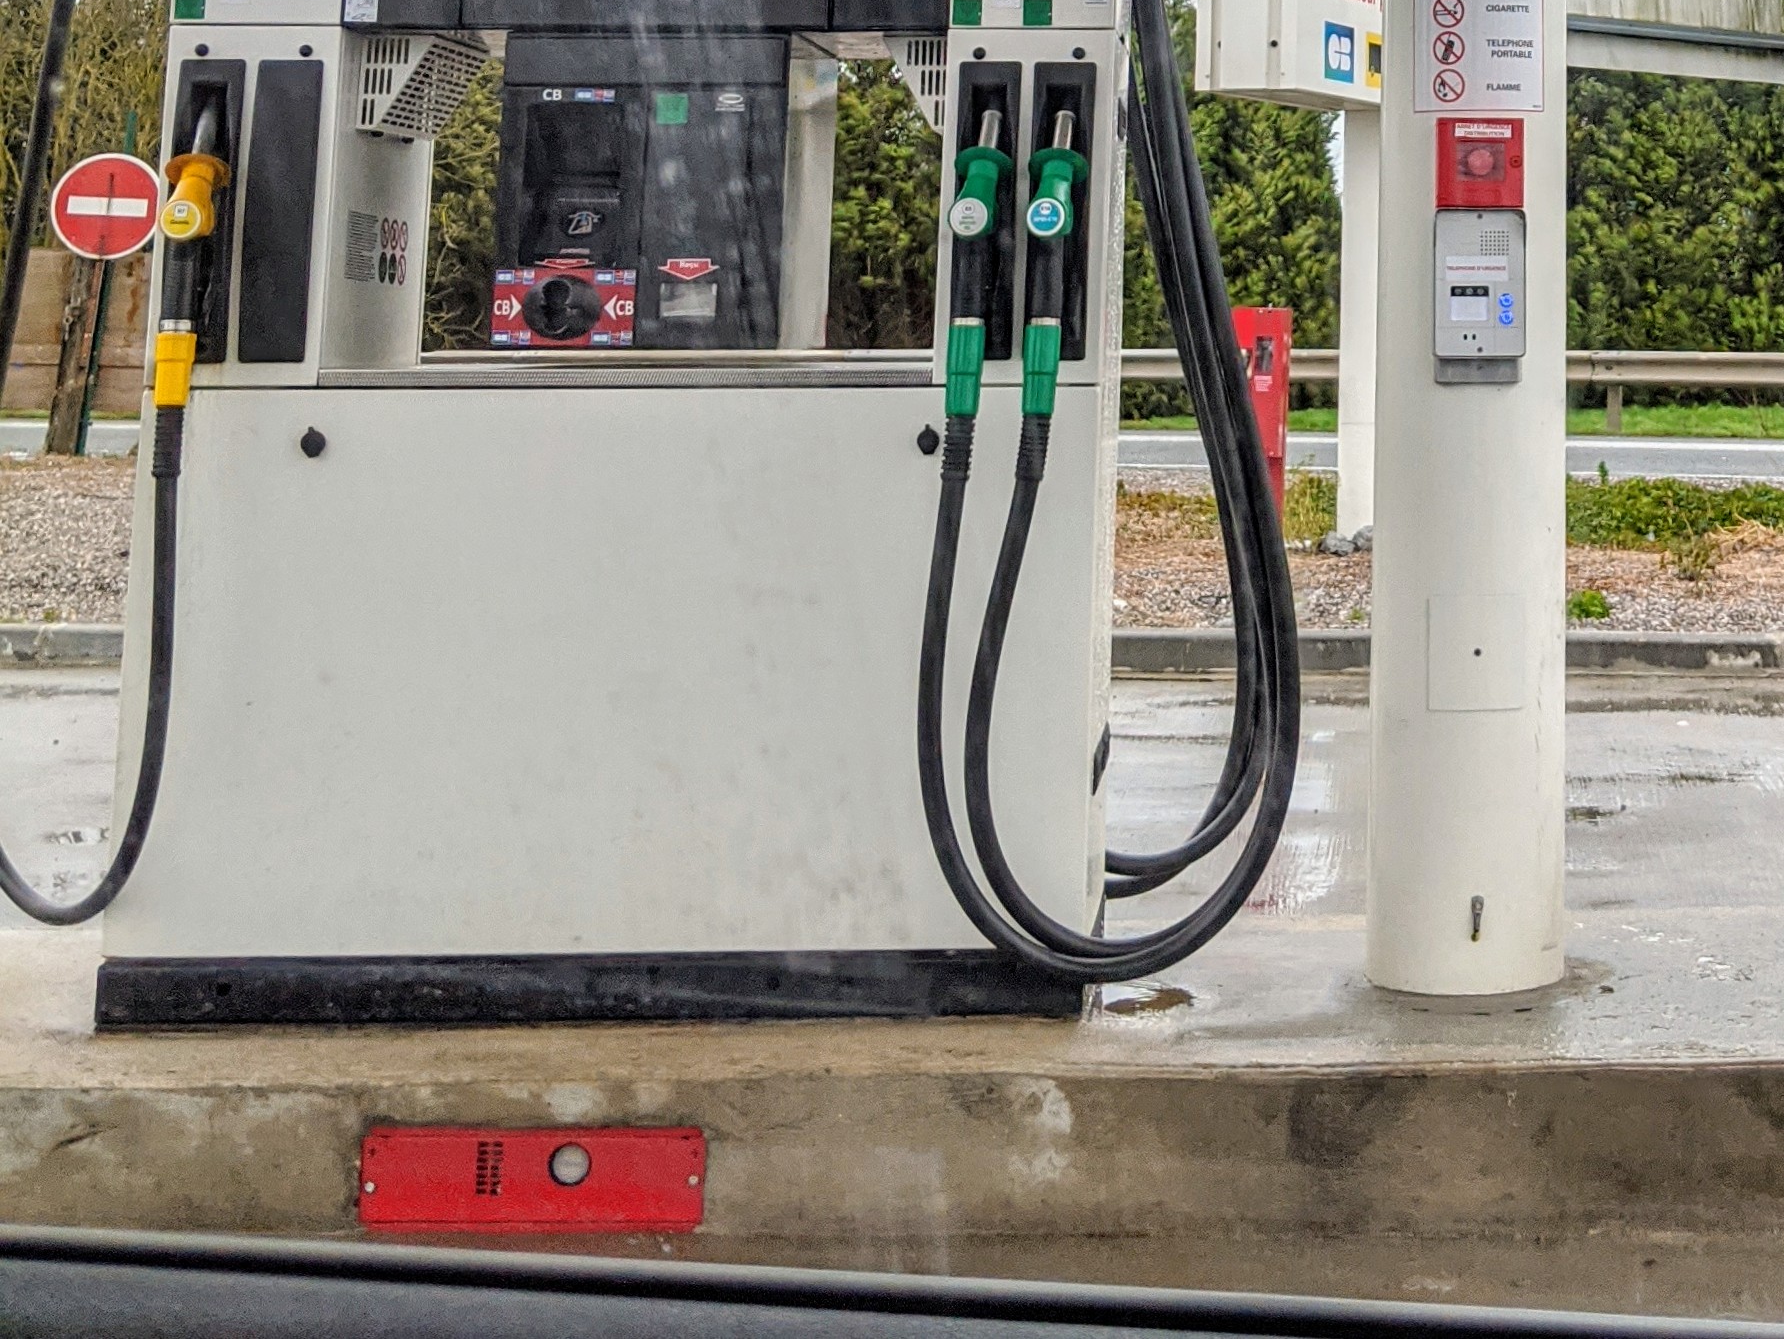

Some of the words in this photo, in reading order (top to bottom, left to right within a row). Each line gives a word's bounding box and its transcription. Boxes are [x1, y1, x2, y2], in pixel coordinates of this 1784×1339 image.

[1486, 4, 1530, 13] CIGARETTE
[1486, 39, 1534, 48] TELEPHONE
[1491, 49, 1533, 59] PORTABLE
[1486, 83, 1521, 92] FLAMME
[542, 89, 563, 102] CB
[494, 299, 511, 315] CB
[616, 299, 634, 316] CB
